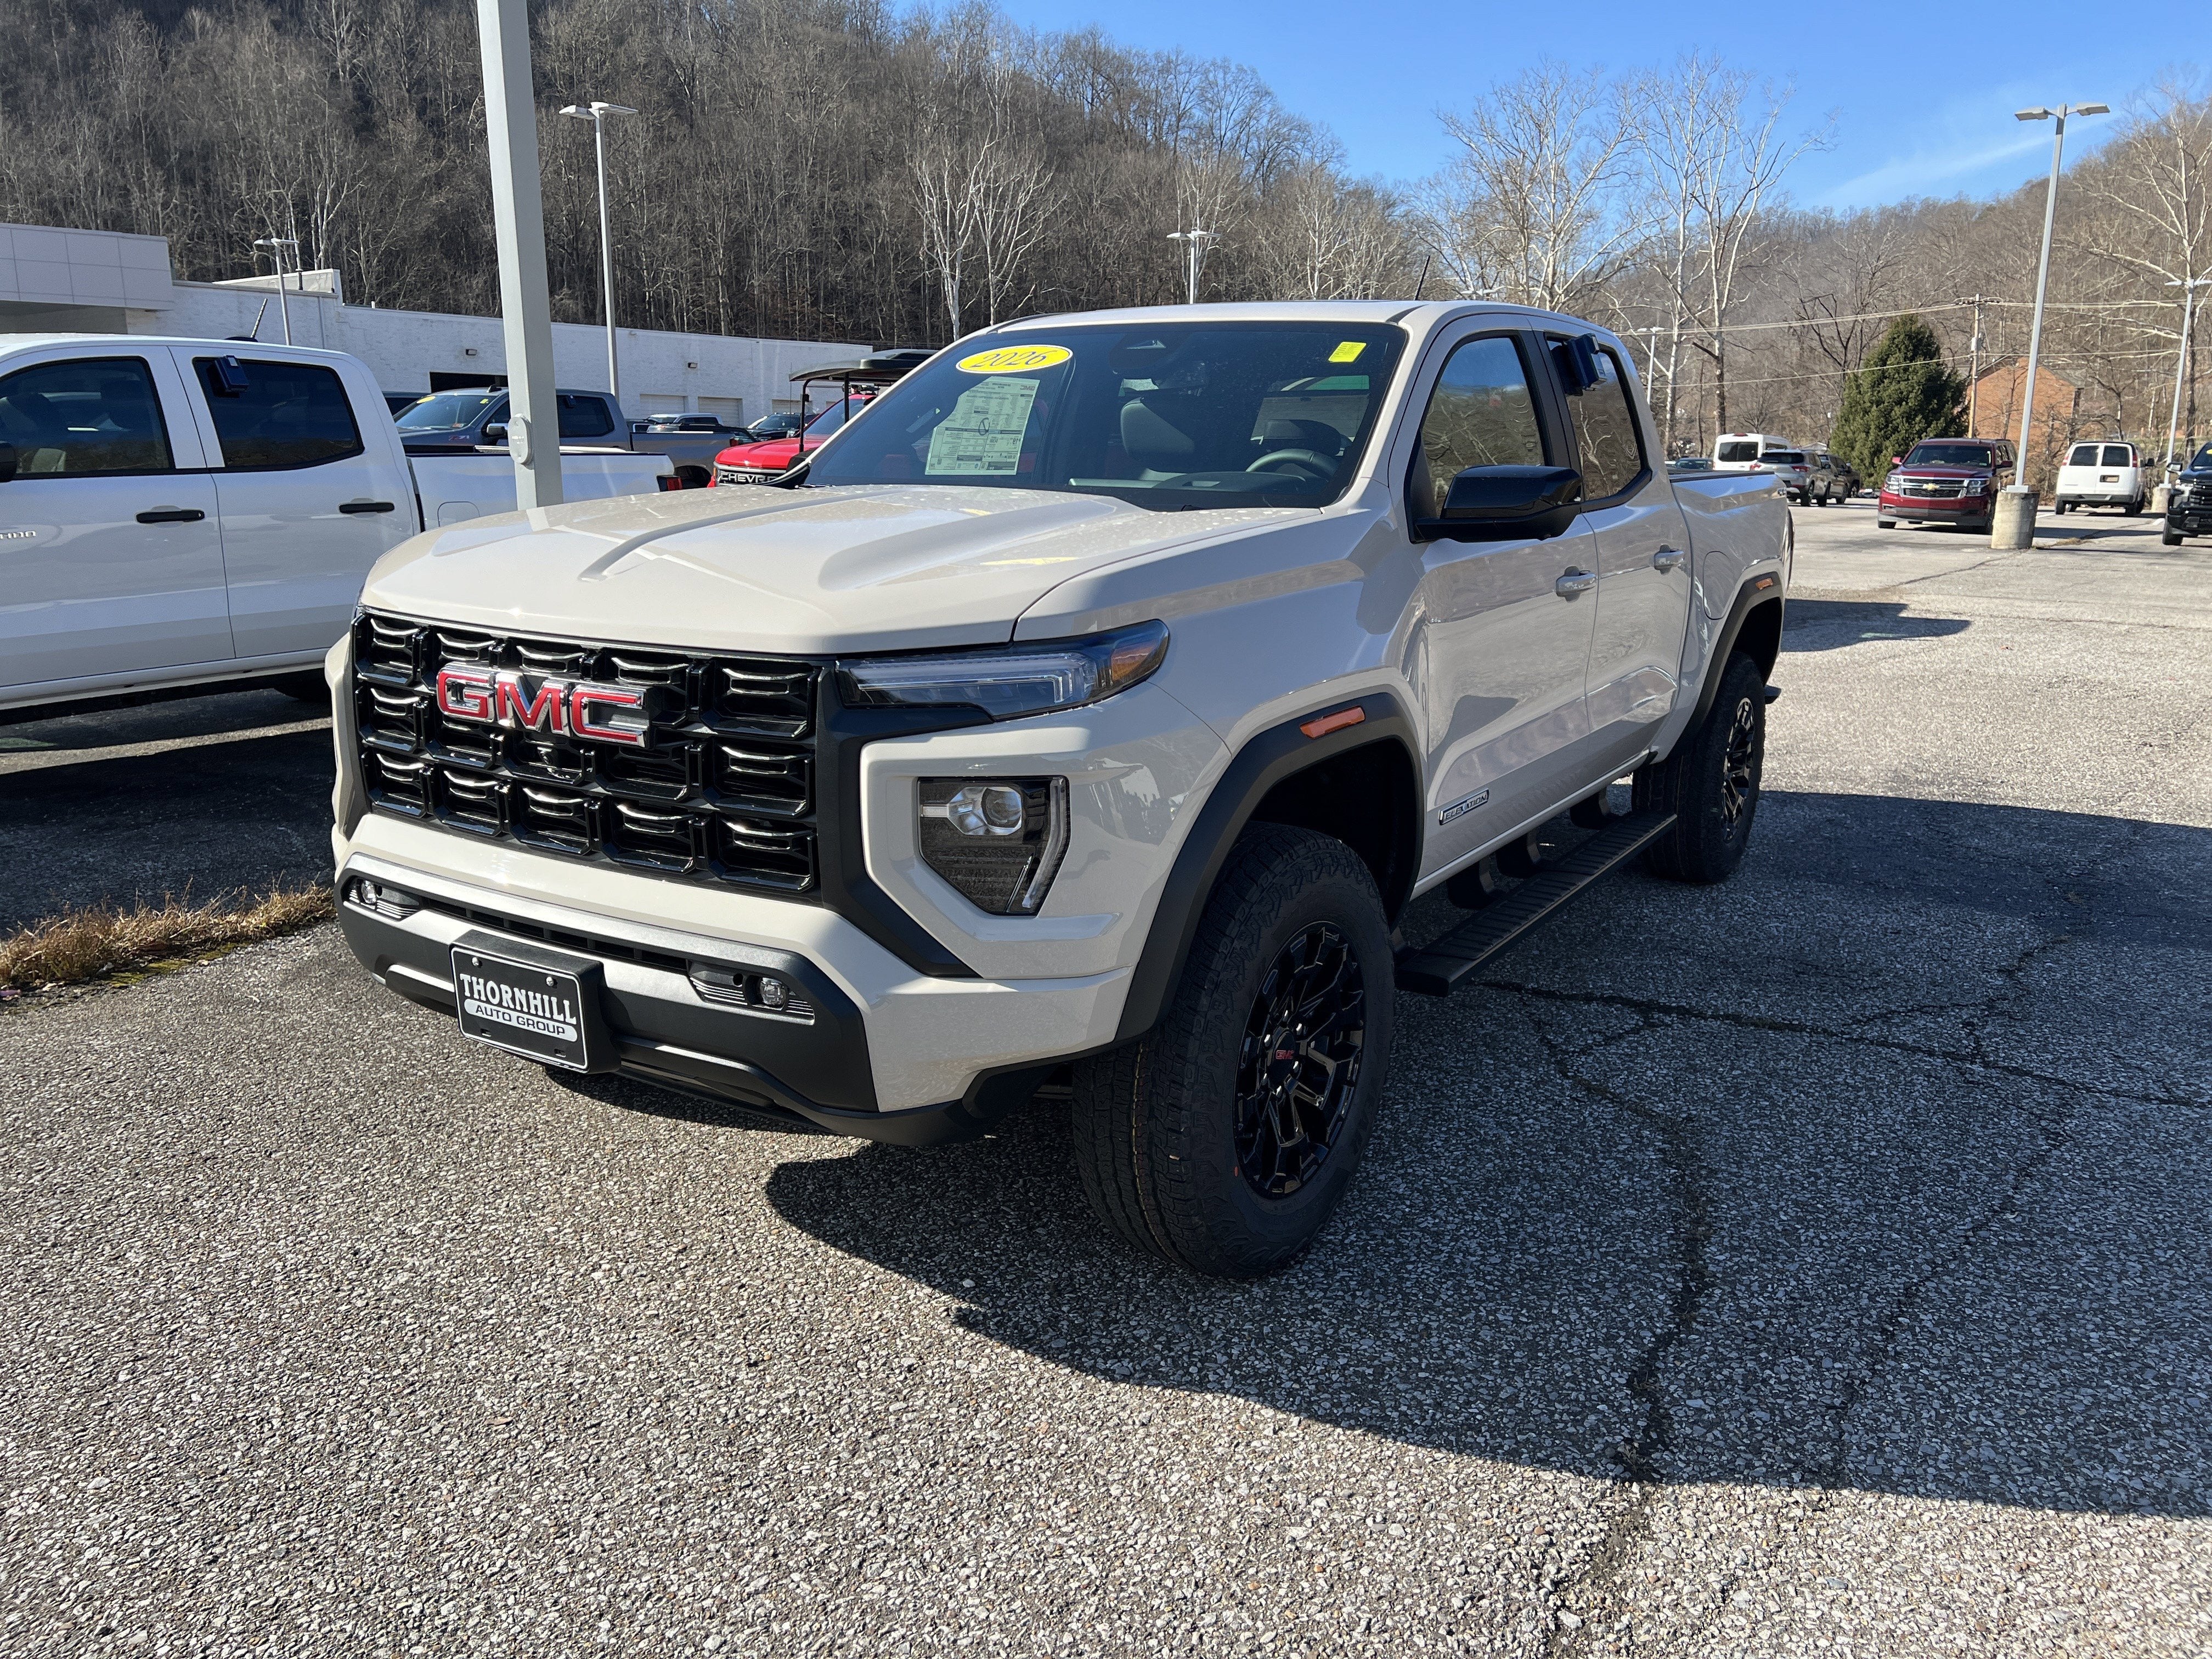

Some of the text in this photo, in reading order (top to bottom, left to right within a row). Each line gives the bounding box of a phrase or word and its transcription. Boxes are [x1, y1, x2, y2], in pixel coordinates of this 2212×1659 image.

[968, 350, 1058, 368] 2026
[437, 662, 646, 747] GMC
[1444, 794, 1487, 820] ELEVATION
[460, 973, 577, 1024] THORNHILL
[475, 1005, 565, 1036] AUTO GROUP
[1276, 1049, 1294, 1059] GMC
